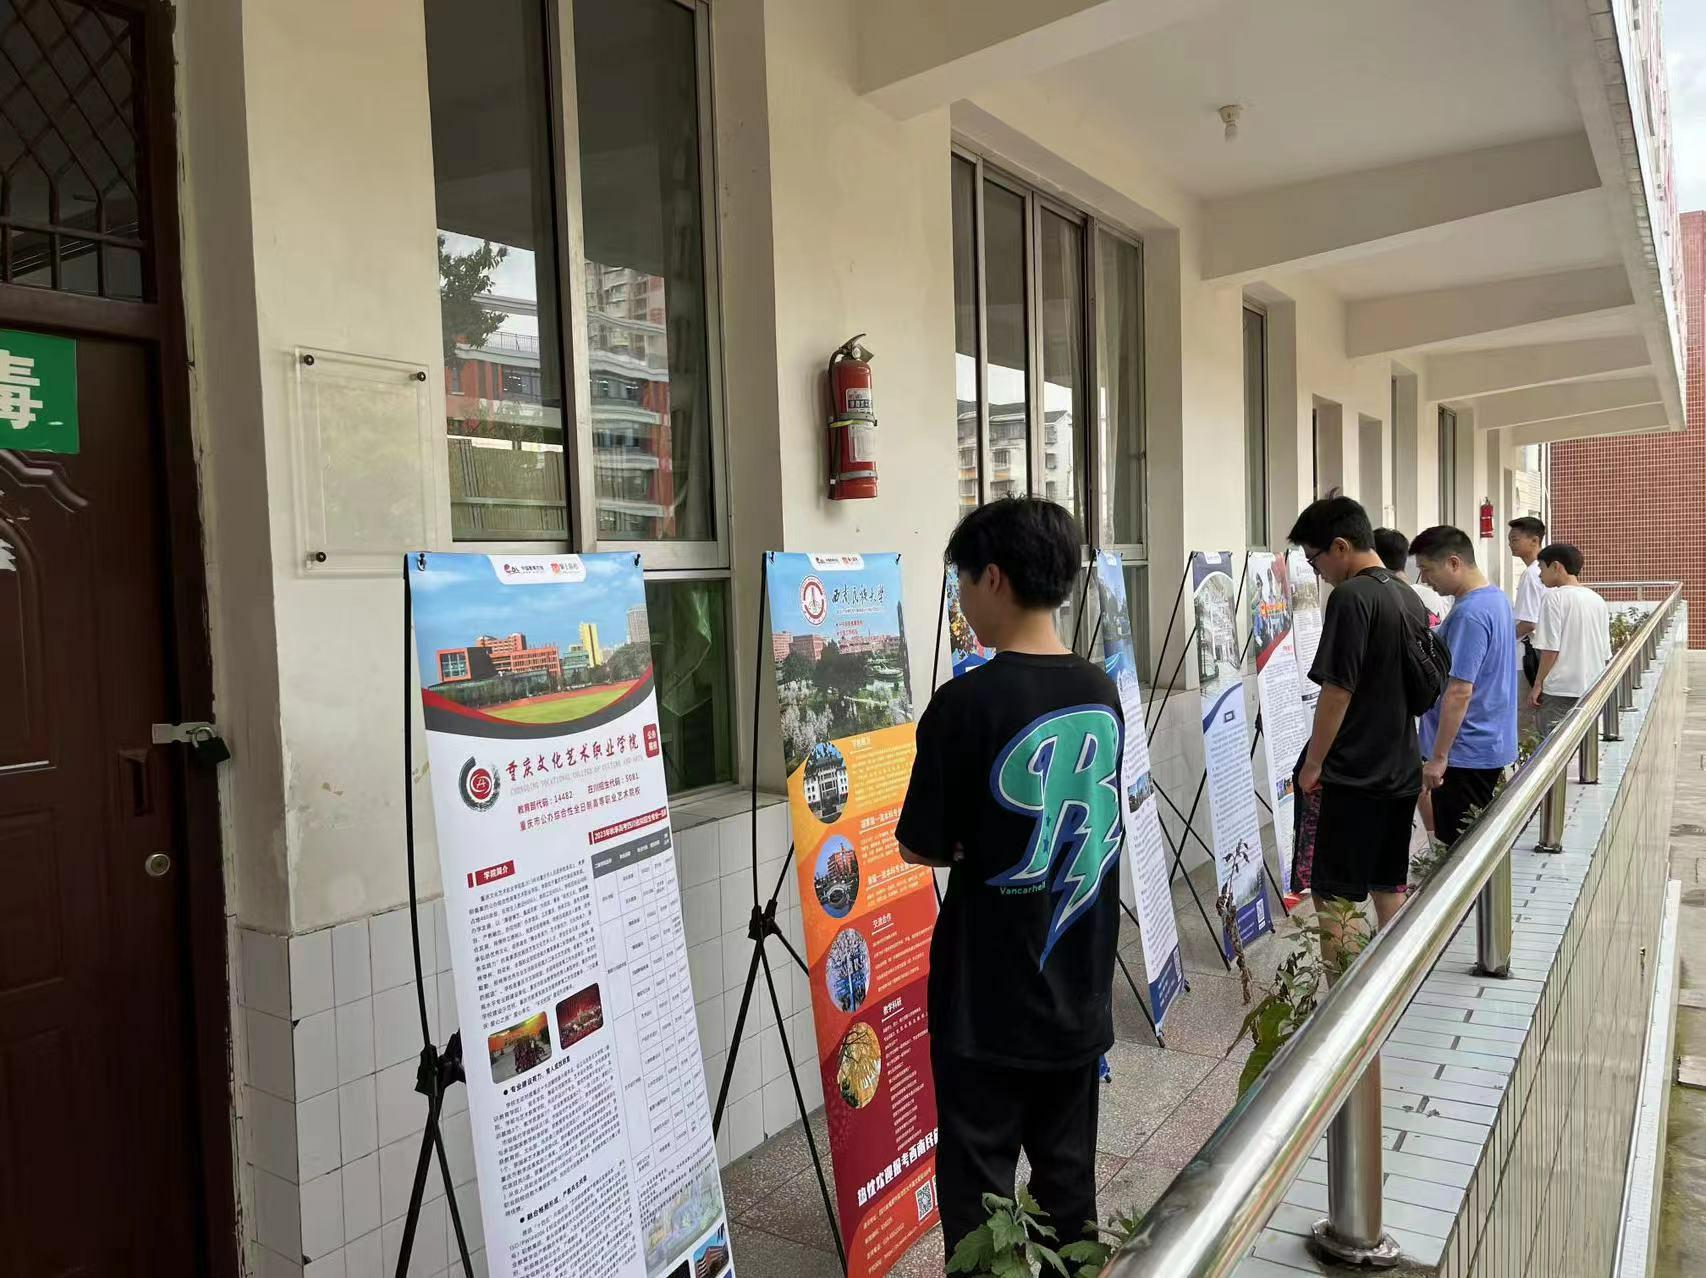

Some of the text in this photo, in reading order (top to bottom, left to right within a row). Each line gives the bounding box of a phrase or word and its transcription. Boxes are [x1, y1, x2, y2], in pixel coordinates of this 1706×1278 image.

[505, 732, 639, 782] 重庆文化艺术职业学院
